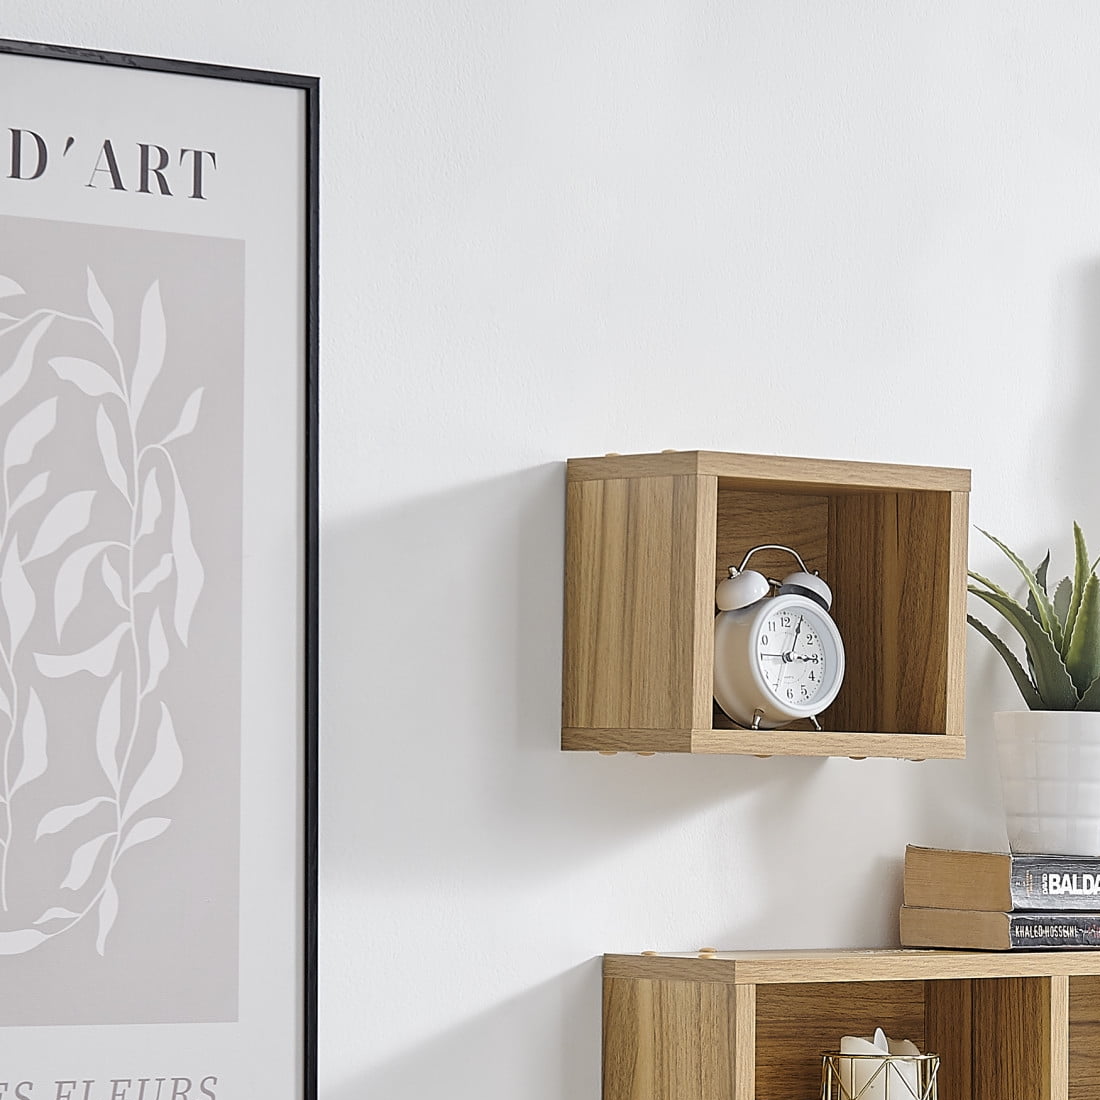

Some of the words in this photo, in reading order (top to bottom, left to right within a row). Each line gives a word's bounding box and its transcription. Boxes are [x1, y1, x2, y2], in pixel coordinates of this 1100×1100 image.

[6, 127, 217, 200] D'ART
[780, 617, 791, 627] 12
[806, 634, 813, 645] 2
[808, 670, 815, 681] 4
[786, 688, 793, 699] 6
[801, 684, 808, 696] 5
[1015, 925, 1043, 939] KHALED
